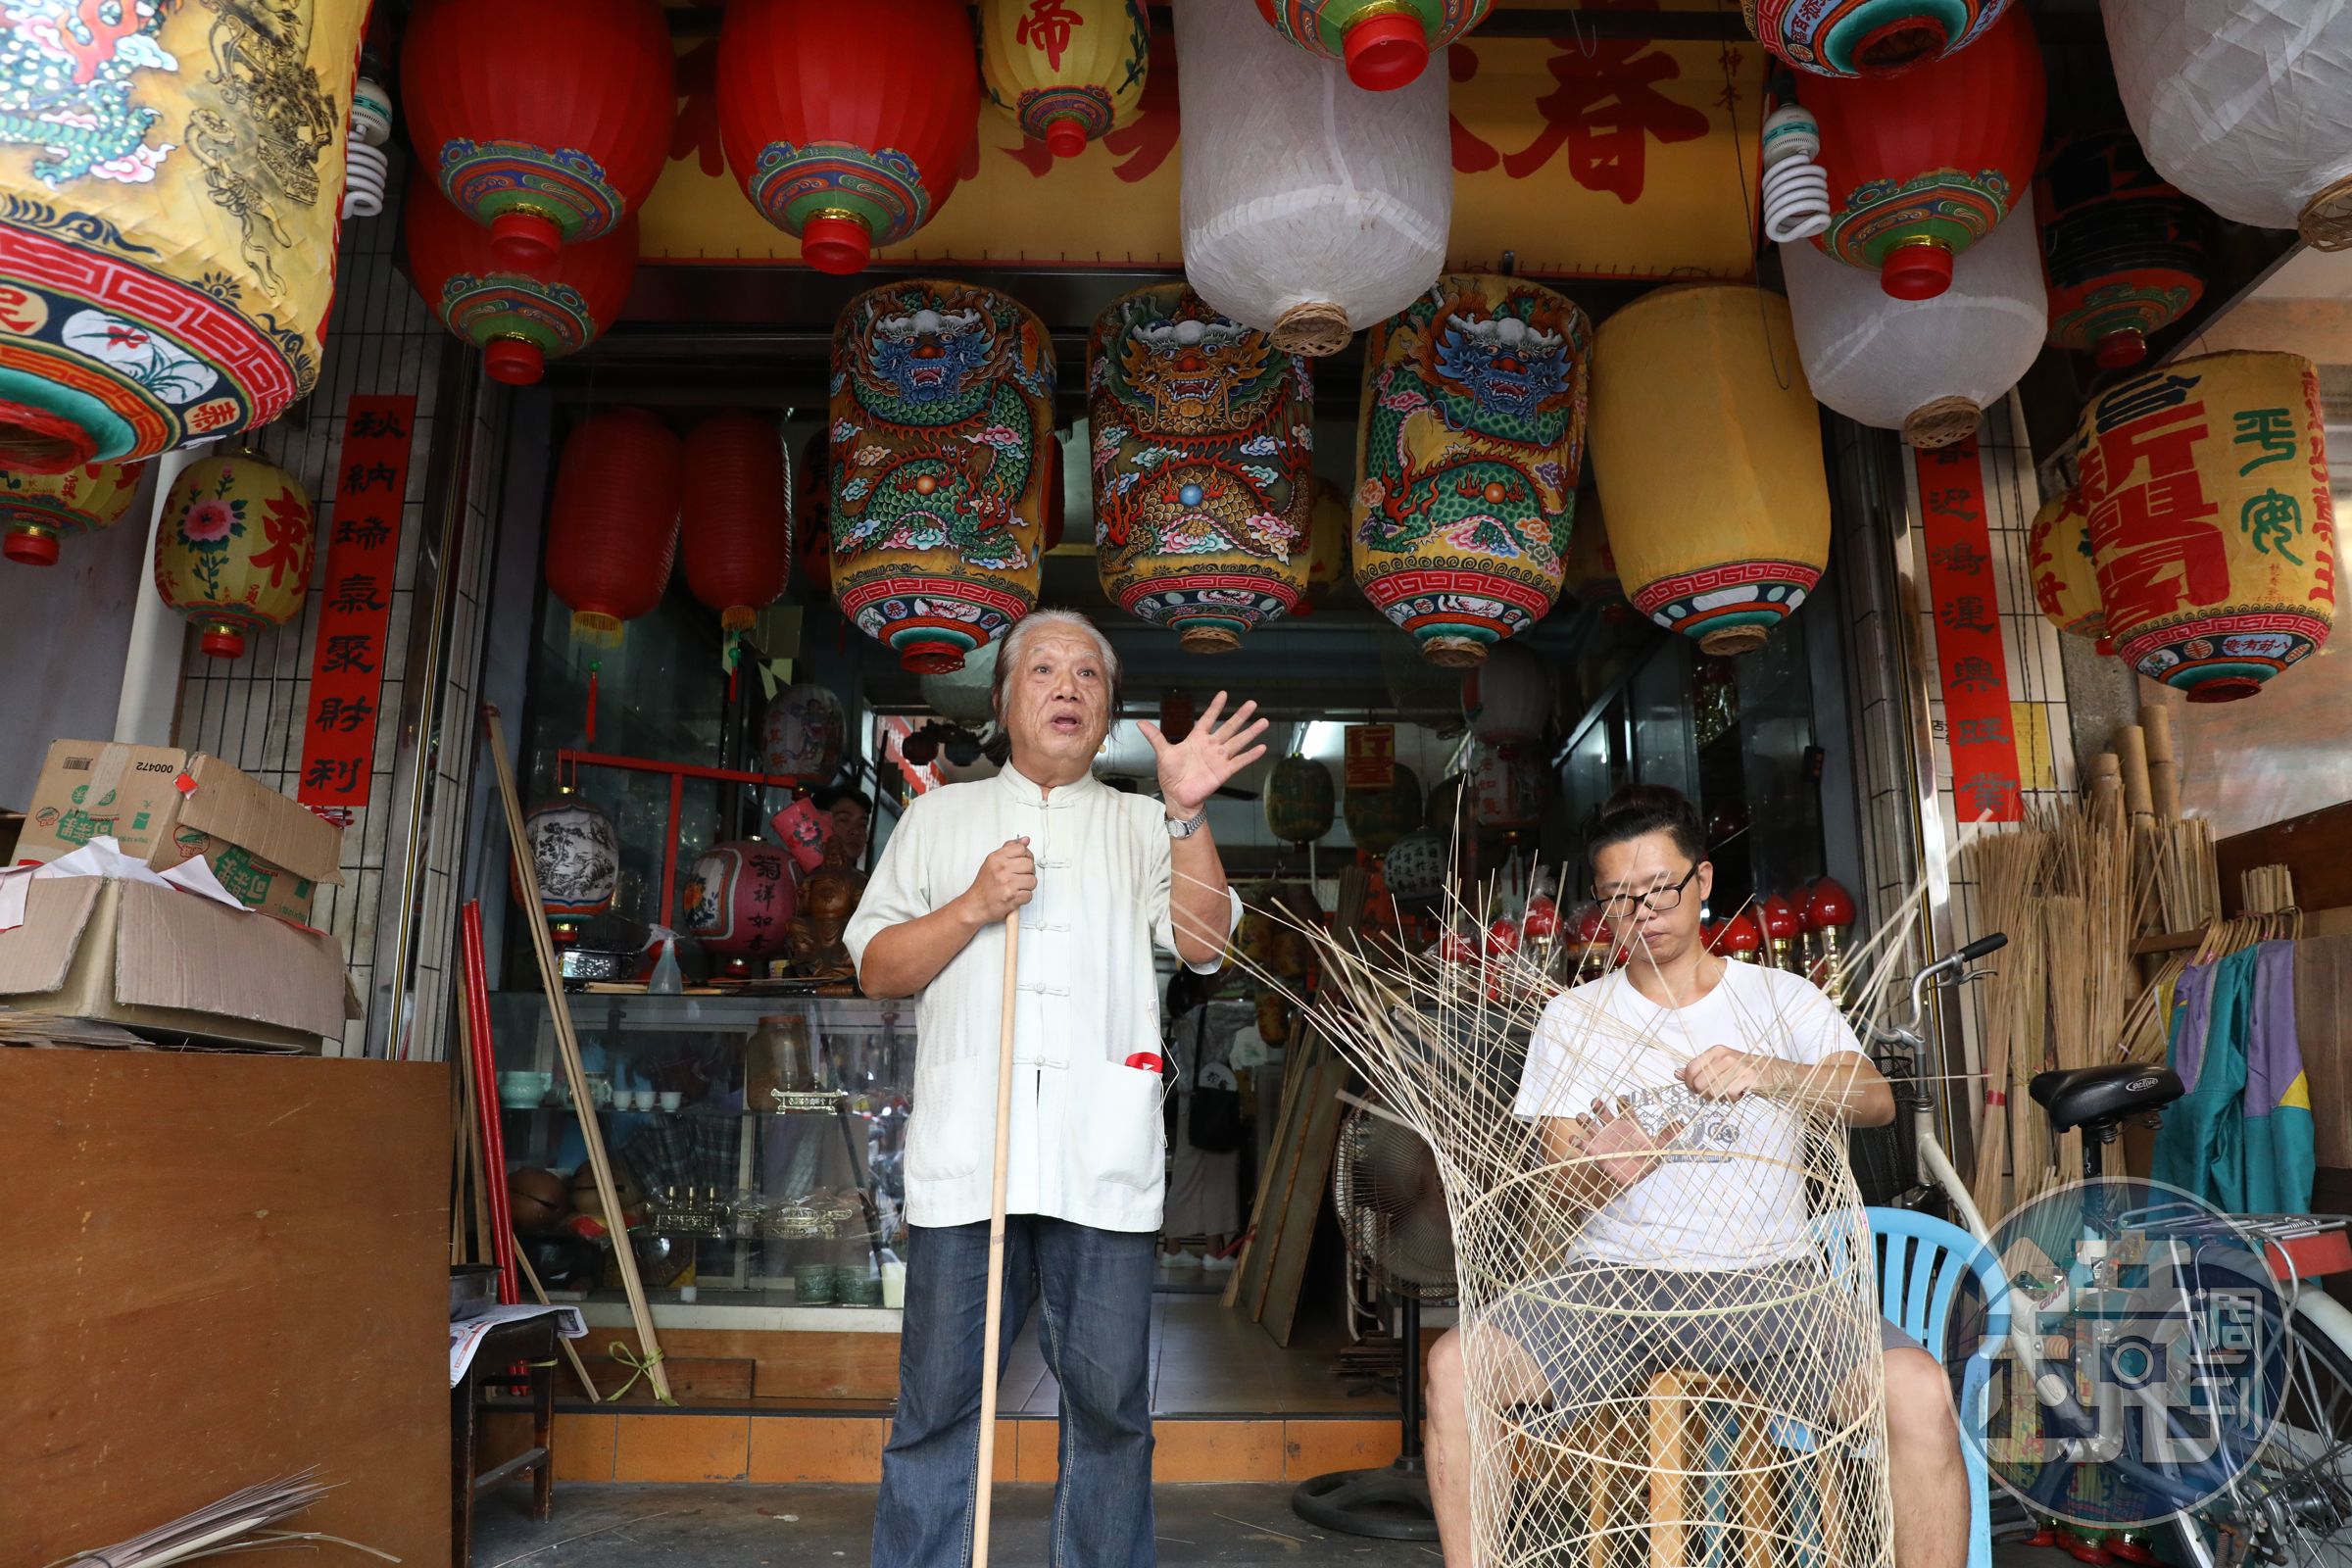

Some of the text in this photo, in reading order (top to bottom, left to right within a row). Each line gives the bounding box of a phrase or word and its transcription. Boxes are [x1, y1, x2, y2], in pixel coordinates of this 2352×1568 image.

[1016, 0, 1082, 72] 帝
[2233, 407, 2304, 566] 平安
[305, 411, 405, 793] 秋納瑞氣聚財利
[136, 760, 173, 773] 000472
